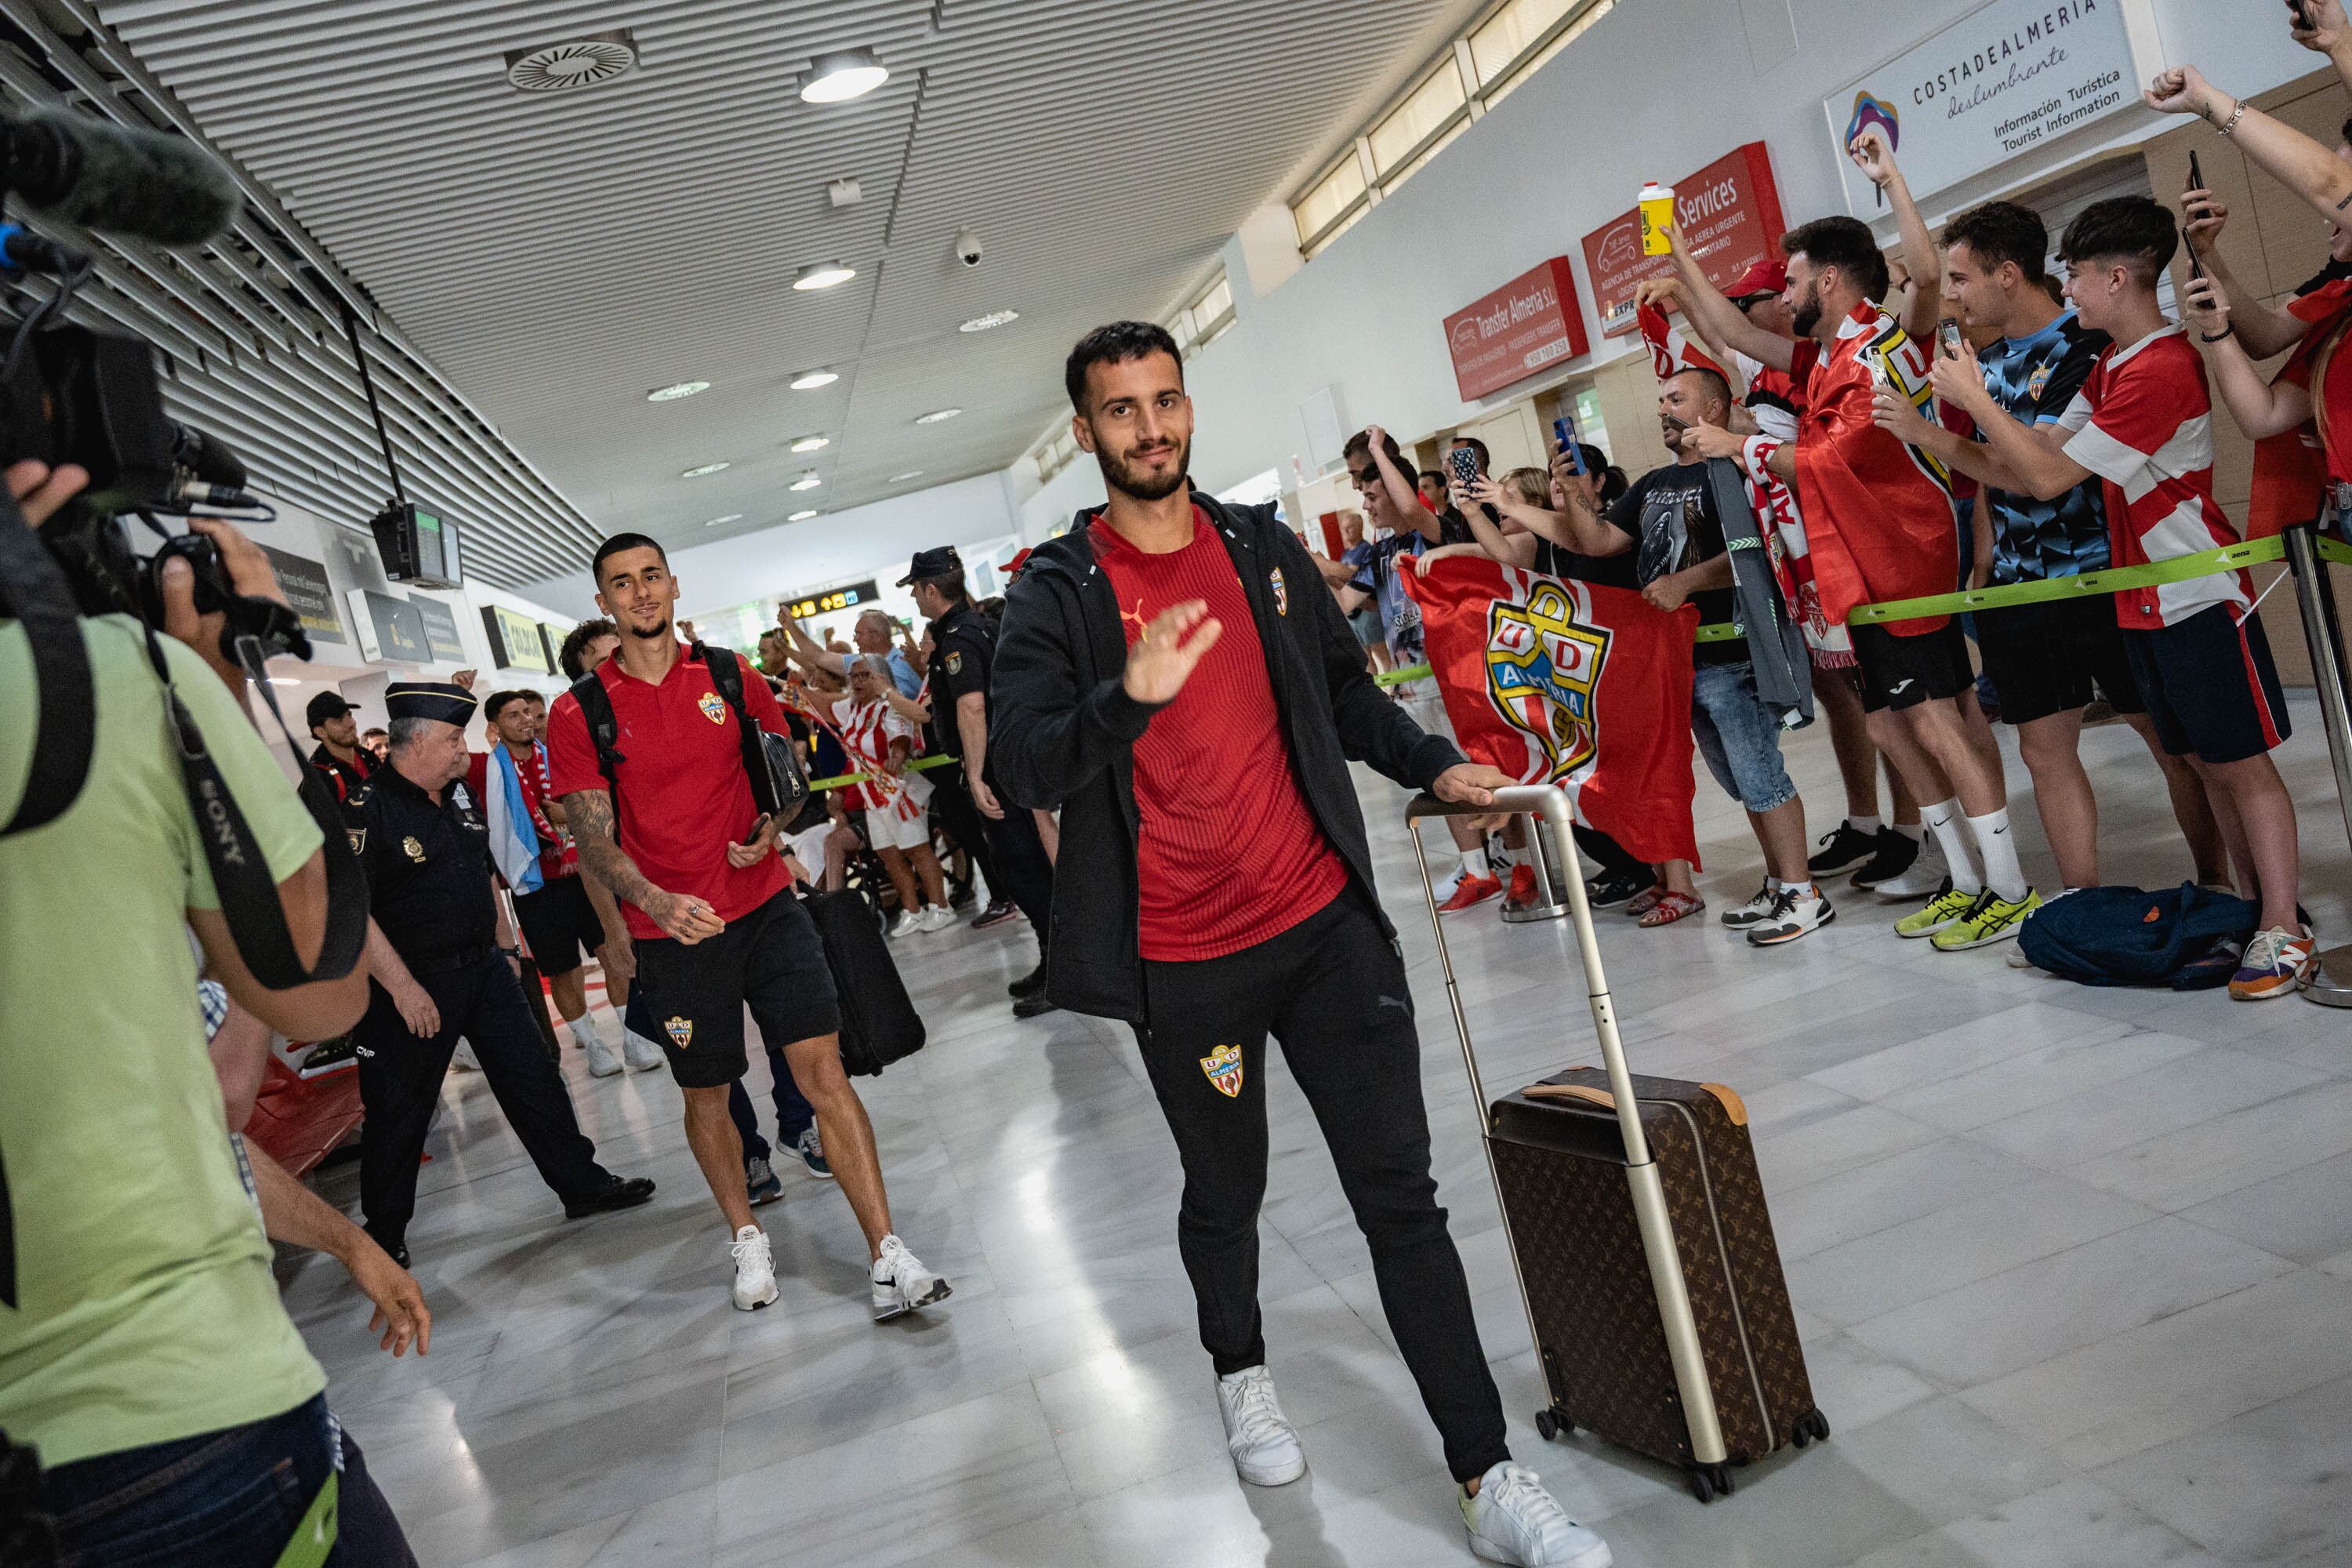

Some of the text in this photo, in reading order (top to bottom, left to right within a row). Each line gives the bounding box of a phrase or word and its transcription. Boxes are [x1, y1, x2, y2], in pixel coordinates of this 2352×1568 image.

[1947, 46, 2069, 118] deslumbrante
[1994, 70, 2121, 138] Información Turística
[2002, 90, 2121, 153] Tourist Information
[1678, 177, 1737, 229] Services
[1602, 274, 1624, 291] AGENCIA
[1624, 268, 1632, 281] DE
[1695, 227, 1715, 244] AEREA
[1715, 210, 1747, 234] URGENTE
[1475, 303, 1510, 340] Transfer
[1508, 285, 1544, 325] Almería
[2231, 550, 2250, 559] aena
[1497, 622, 1581, 671] U D
[199, 778, 245, 865] SONY
[1210, 1060, 1240, 1078] ALMERIA
[1229, 1051, 1236, 1060] D
